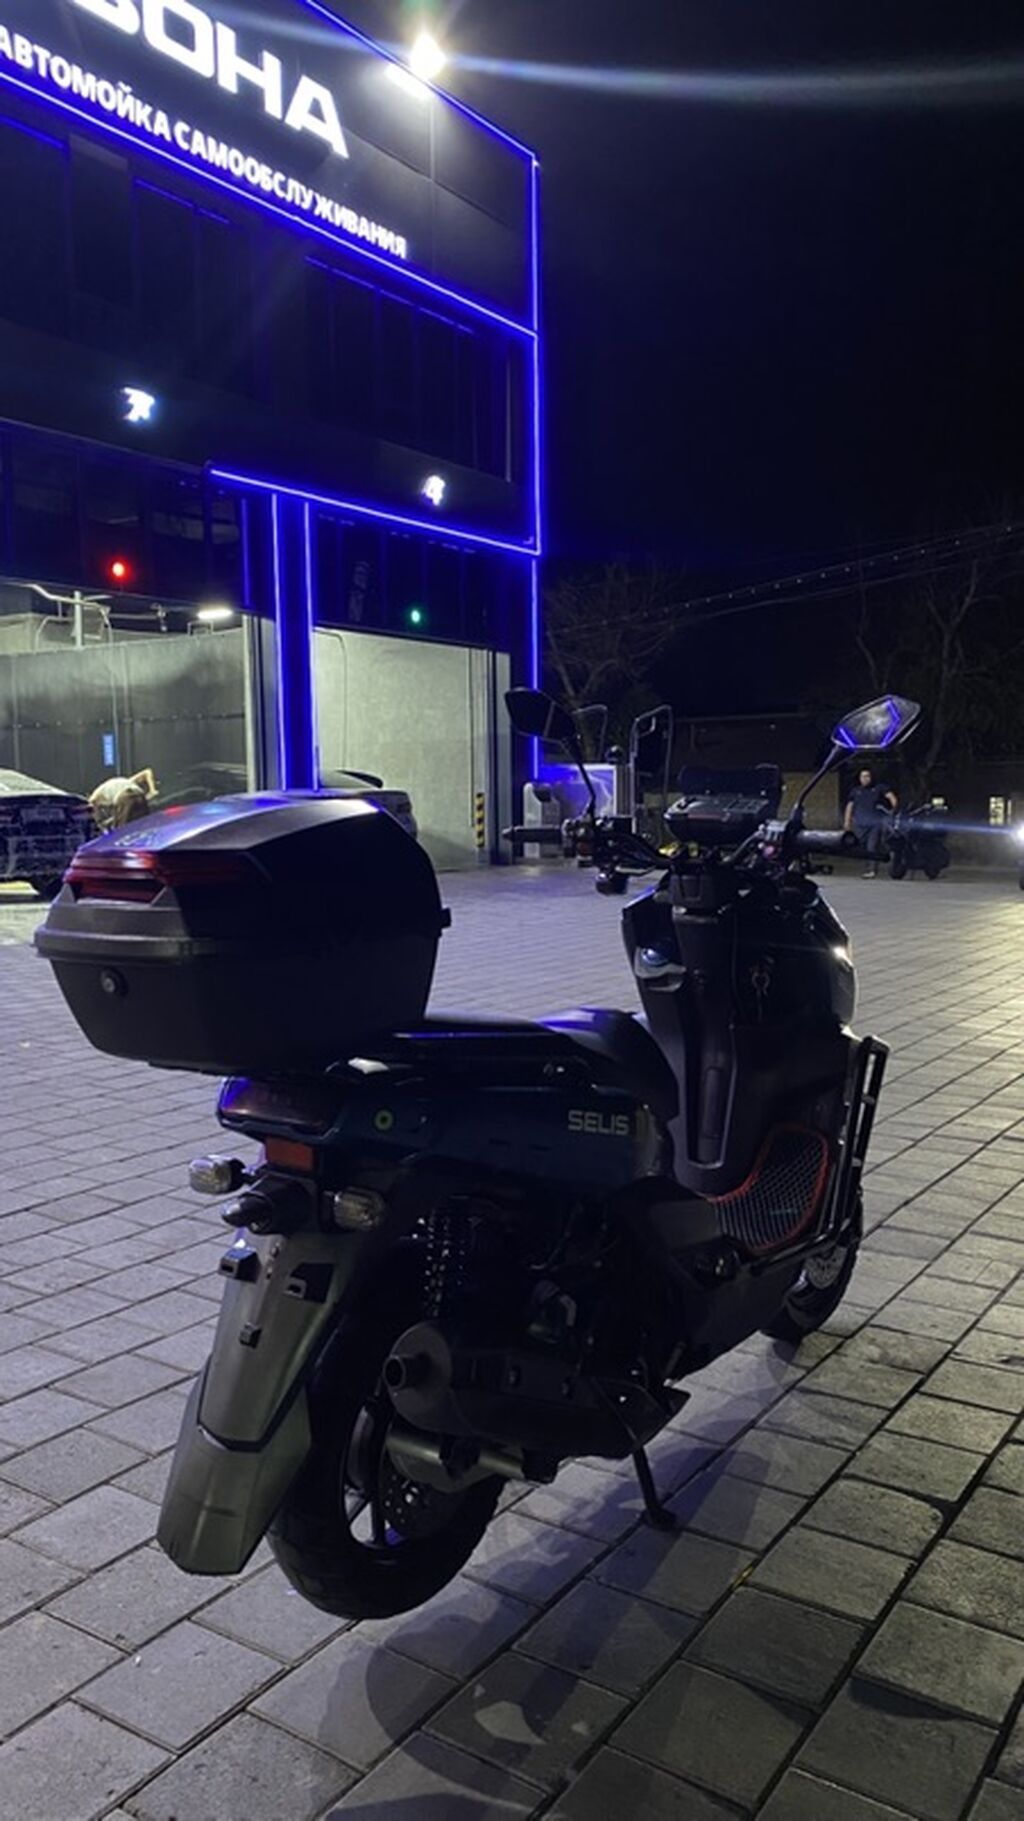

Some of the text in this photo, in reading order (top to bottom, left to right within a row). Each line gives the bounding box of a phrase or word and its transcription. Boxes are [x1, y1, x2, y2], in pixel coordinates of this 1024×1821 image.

[0, 24, 407, 259] АВТОМОЙКА САМООБСЛУЖИВАНИЯ
[567, 1109, 630, 1136] SELIS
